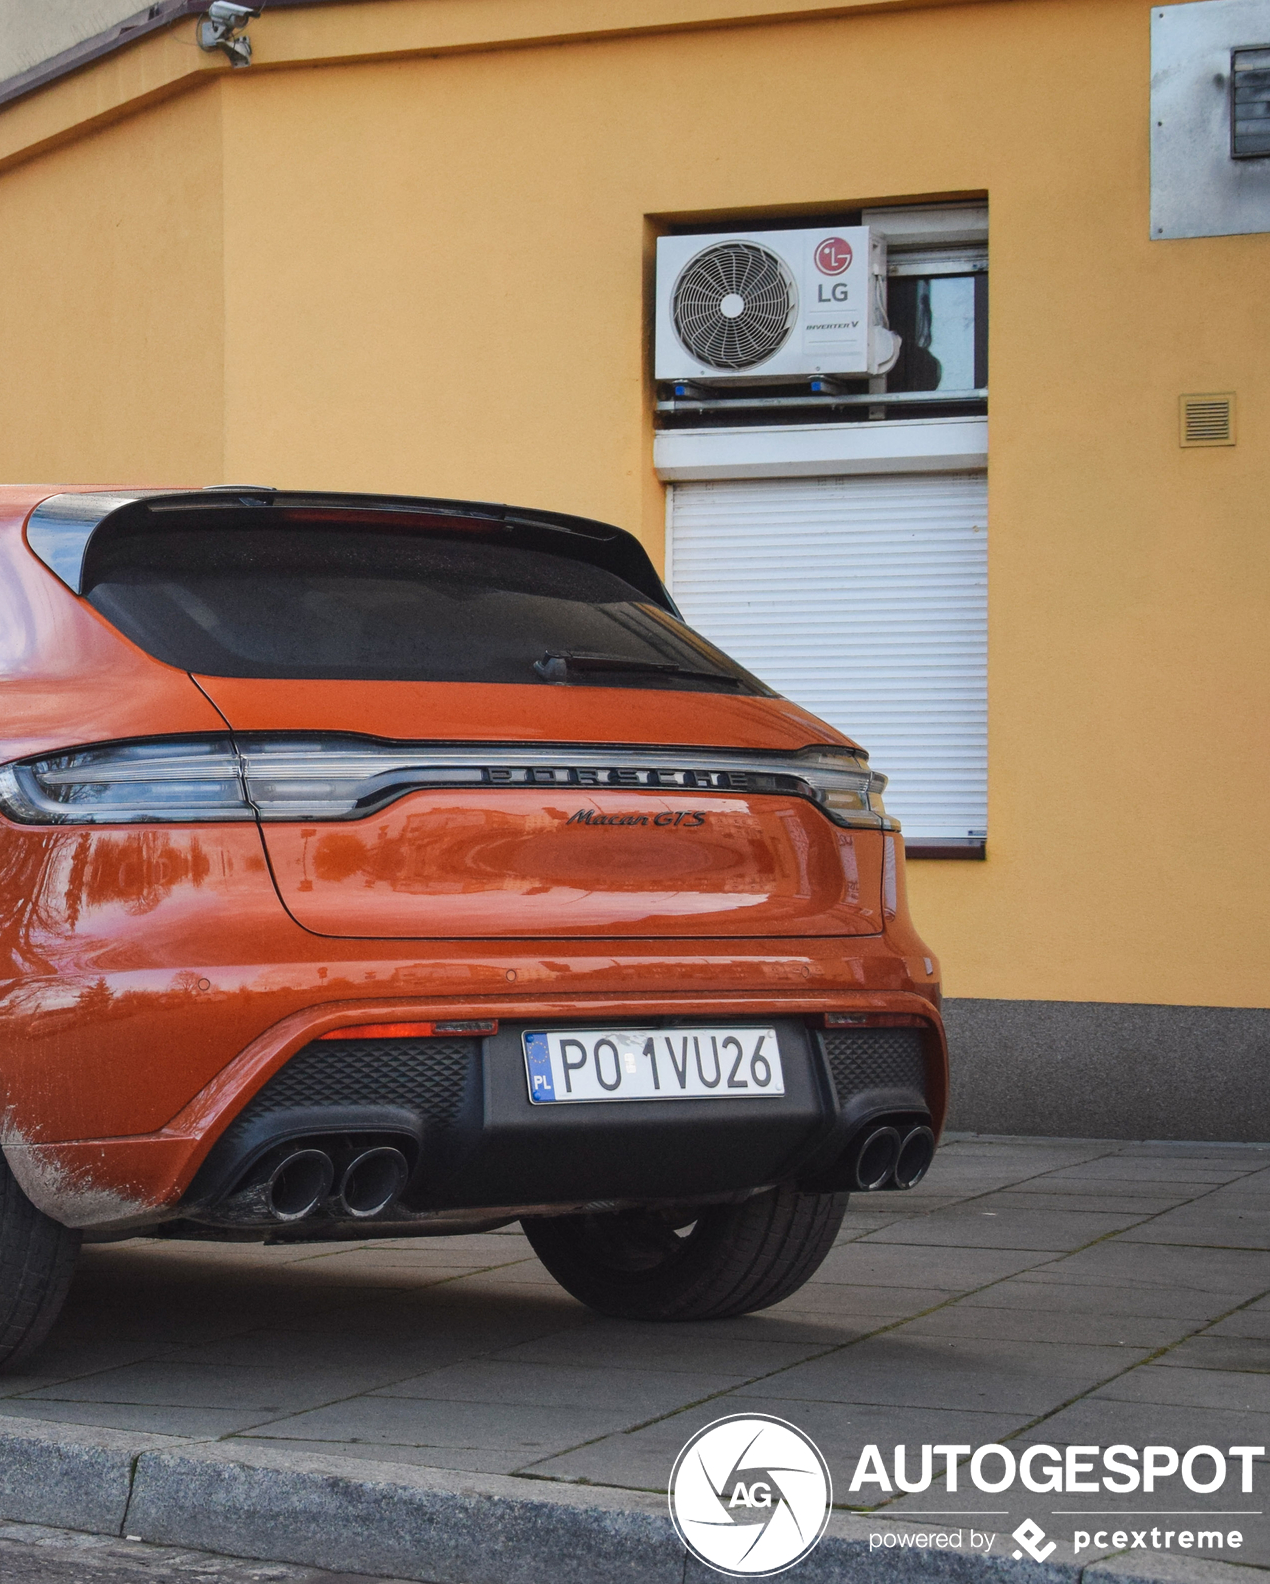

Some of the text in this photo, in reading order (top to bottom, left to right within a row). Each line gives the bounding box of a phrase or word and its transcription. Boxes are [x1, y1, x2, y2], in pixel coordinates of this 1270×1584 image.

[817, 283, 849, 303] LG
[806, 320, 860, 331] INVERTER V
[487, 766, 749, 787] PORSCHE
[565, 808, 706, 827] Macan GTS
[558, 1035, 772, 1093] PO 1VU26
[533, 1075, 552, 1090] PL
